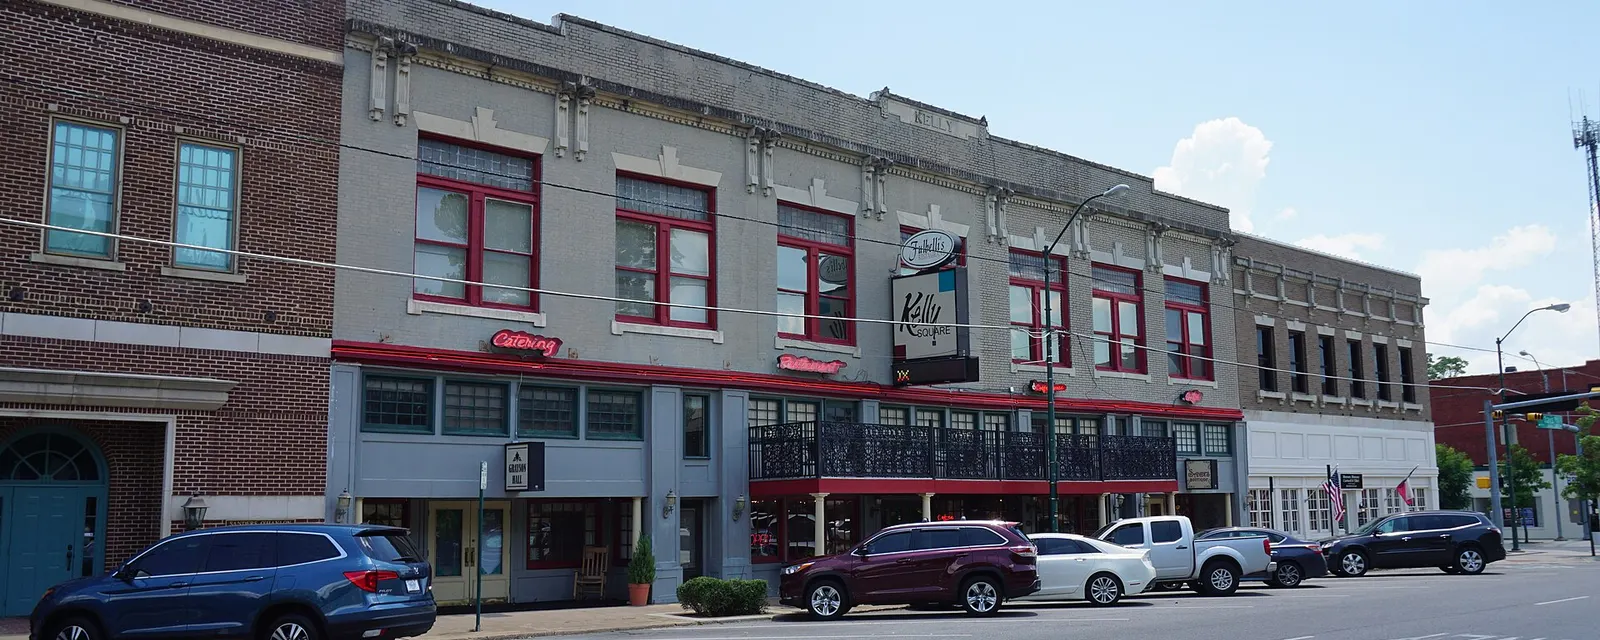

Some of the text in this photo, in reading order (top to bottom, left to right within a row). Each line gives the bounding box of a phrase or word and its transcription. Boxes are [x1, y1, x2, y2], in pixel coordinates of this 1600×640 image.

[915, 109, 952, 133] KELLY
[900, 291, 941, 340] Kelly
[917, 326, 951, 338] SQUARE
[493, 332, 556, 357] Catering
[511, 474, 523, 485] HALL
